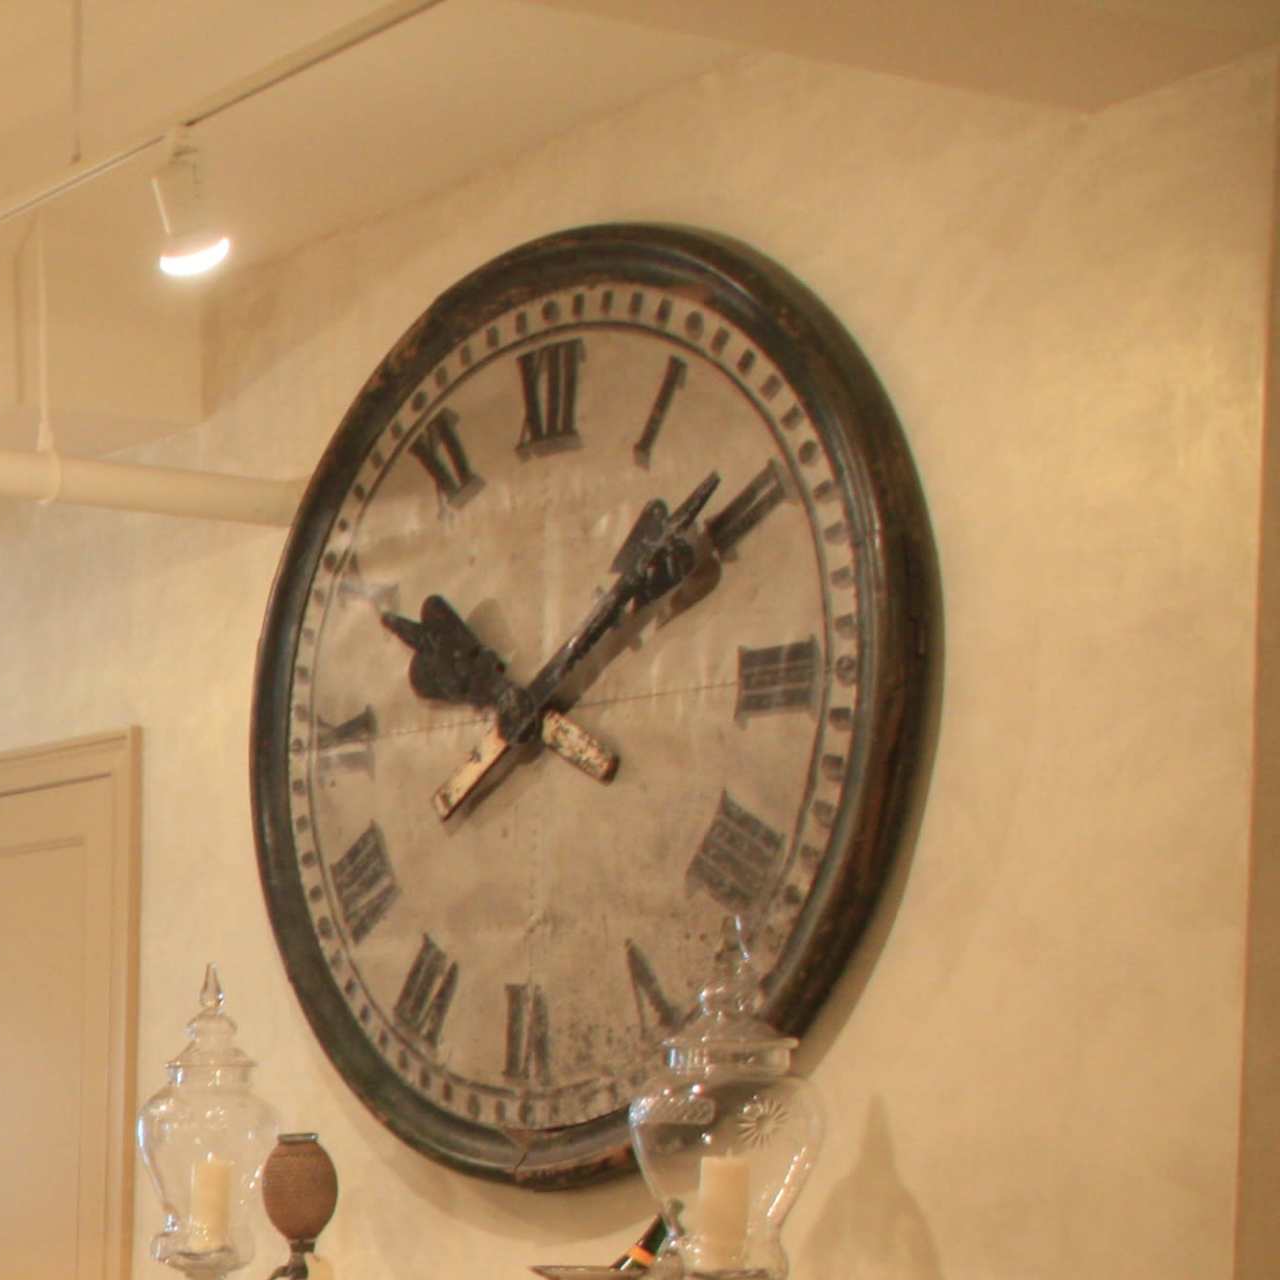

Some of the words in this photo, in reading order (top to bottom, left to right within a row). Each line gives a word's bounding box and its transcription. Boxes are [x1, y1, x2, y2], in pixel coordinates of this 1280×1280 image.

[515, 338, 586, 462] XII
[634, 355, 687, 470] I
[734, 633, 820, 730] III
